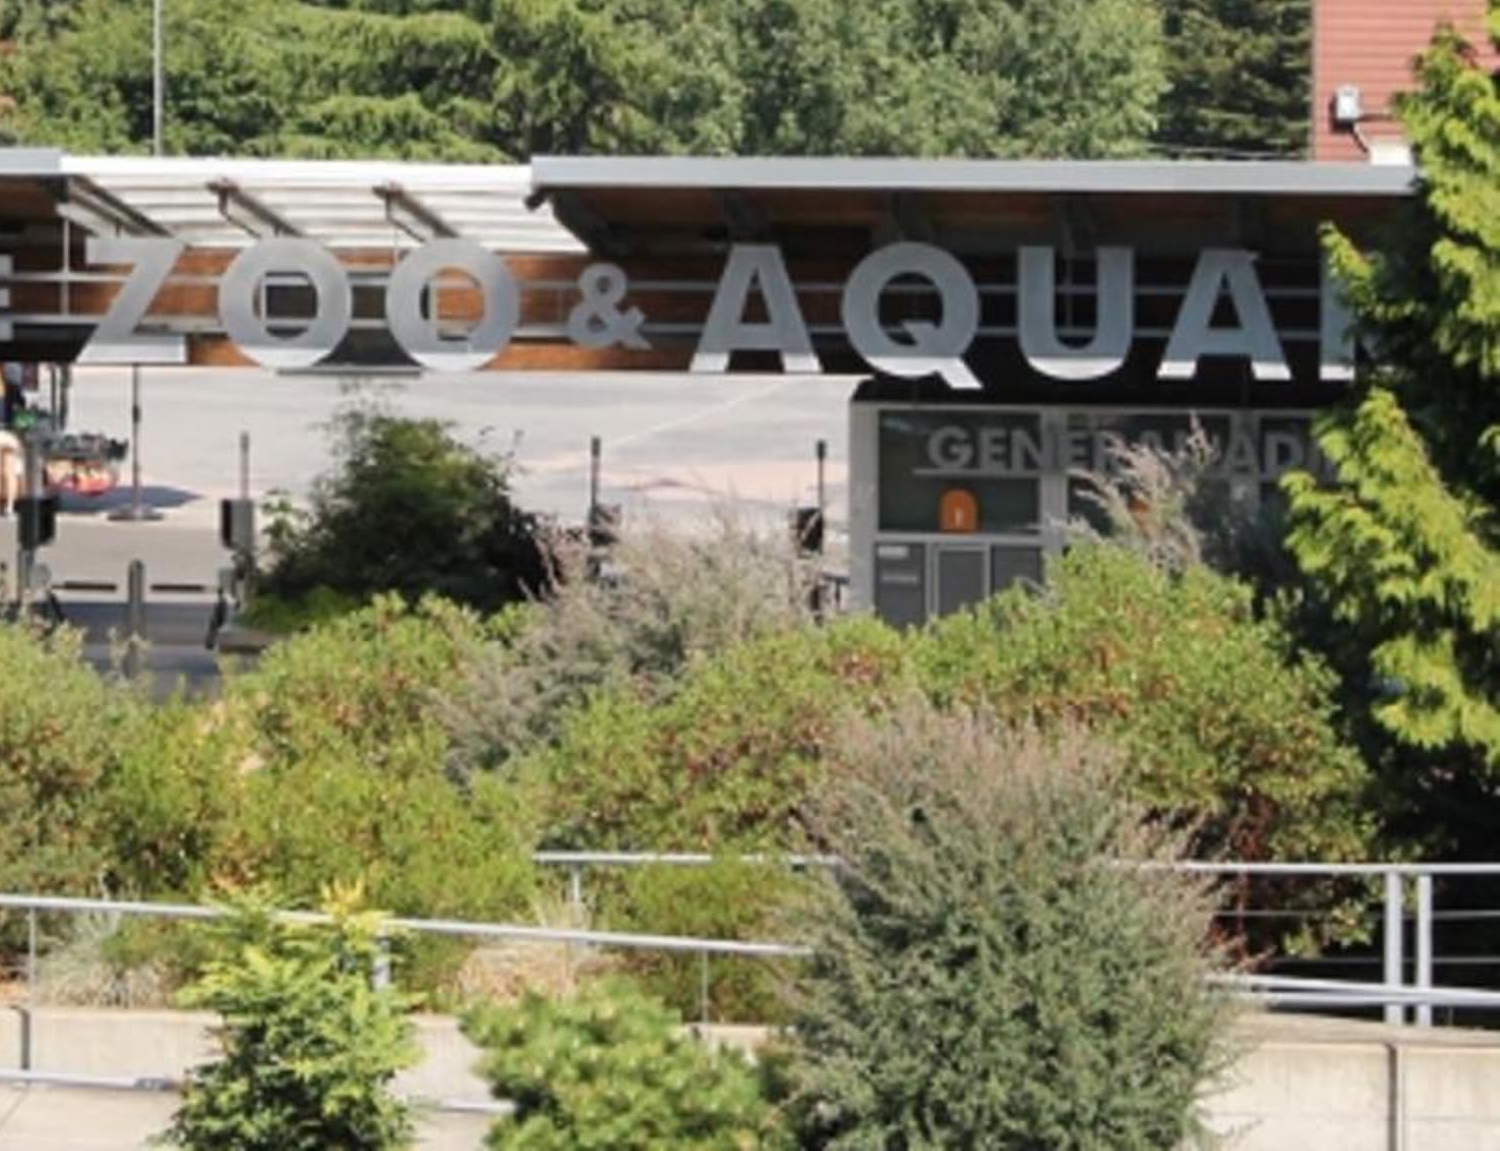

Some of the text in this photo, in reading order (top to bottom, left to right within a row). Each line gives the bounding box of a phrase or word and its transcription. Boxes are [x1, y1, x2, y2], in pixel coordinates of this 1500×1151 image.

[76, 236, 520, 373] ZOO
[568, 262, 652, 349] &
[927, 426, 1200, 473] GENER
